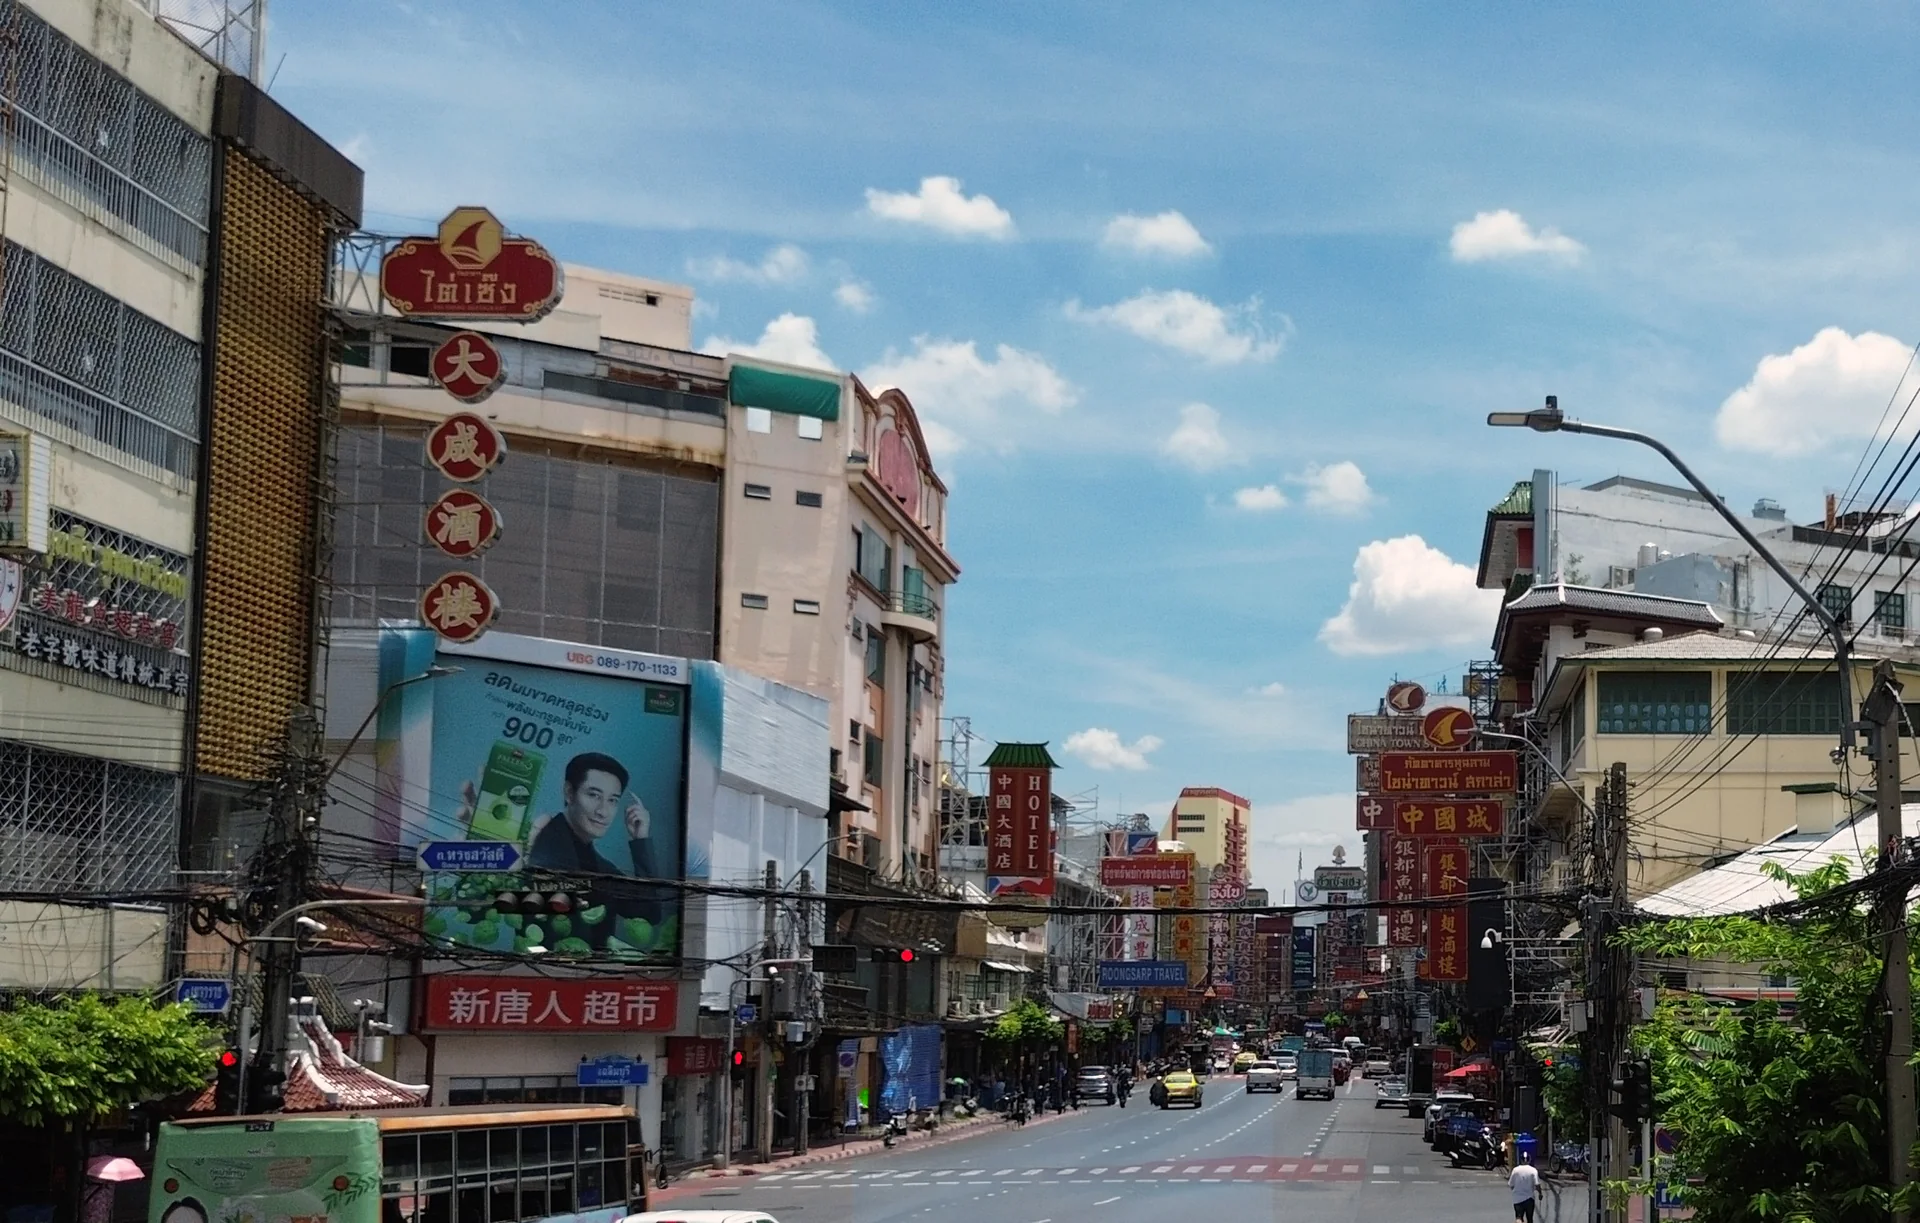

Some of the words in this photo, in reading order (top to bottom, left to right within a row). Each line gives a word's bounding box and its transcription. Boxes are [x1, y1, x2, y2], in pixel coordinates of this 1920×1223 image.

[566, 651, 595, 665] UBG
[597, 656, 678, 677] 089-170-1133
[502, 716, 555, 749] 900
[1356, 738, 1388, 749] CHINA
[1391, 738, 1421, 749] TOWN
[1384, 771, 1459, 790] ไชน่าทาวน์
[995, 773, 1013, 869] 中國大酒店
[1028, 775, 1042, 870] HOTEL
[1402, 804, 1493, 833] 中國城
[1439, 853, 1457, 976] 銀都翅酒樓
[1102, 967, 1153, 981] ROONGSARP
[1154, 967, 1185, 981] TRAVEL
[449, 987, 572, 1026] 新唐人
[583, 989, 660, 1026] 超市
